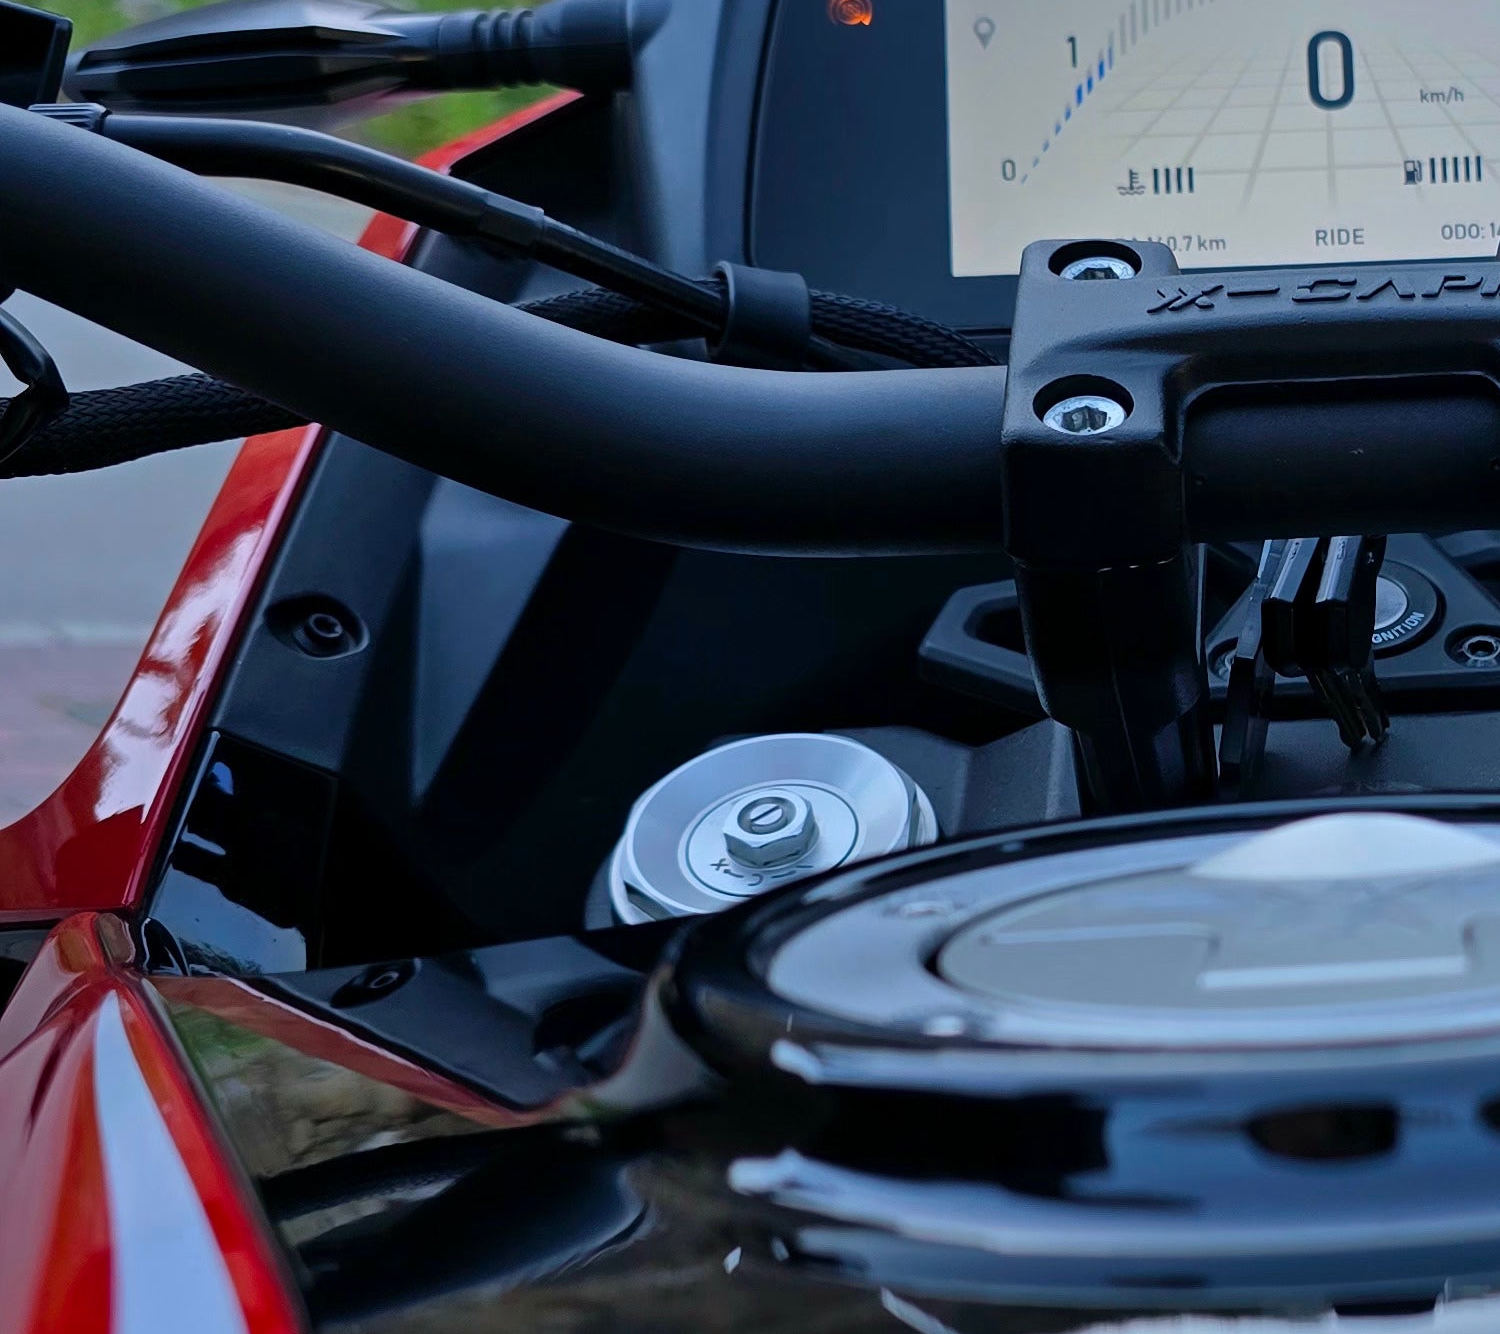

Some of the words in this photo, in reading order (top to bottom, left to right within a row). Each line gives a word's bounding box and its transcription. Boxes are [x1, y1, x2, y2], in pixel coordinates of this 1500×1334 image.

[1066, 35, 1079, 68] 1
[1307, 30, 1355, 112] 0
[1419, 85, 1465, 105] km/h
[1001, 159, 1017, 182] 0
[1197, 234, 1227, 251] km
[1315, 227, 1366, 247] RIDE
[1371, 610, 1425, 644] GNITION
